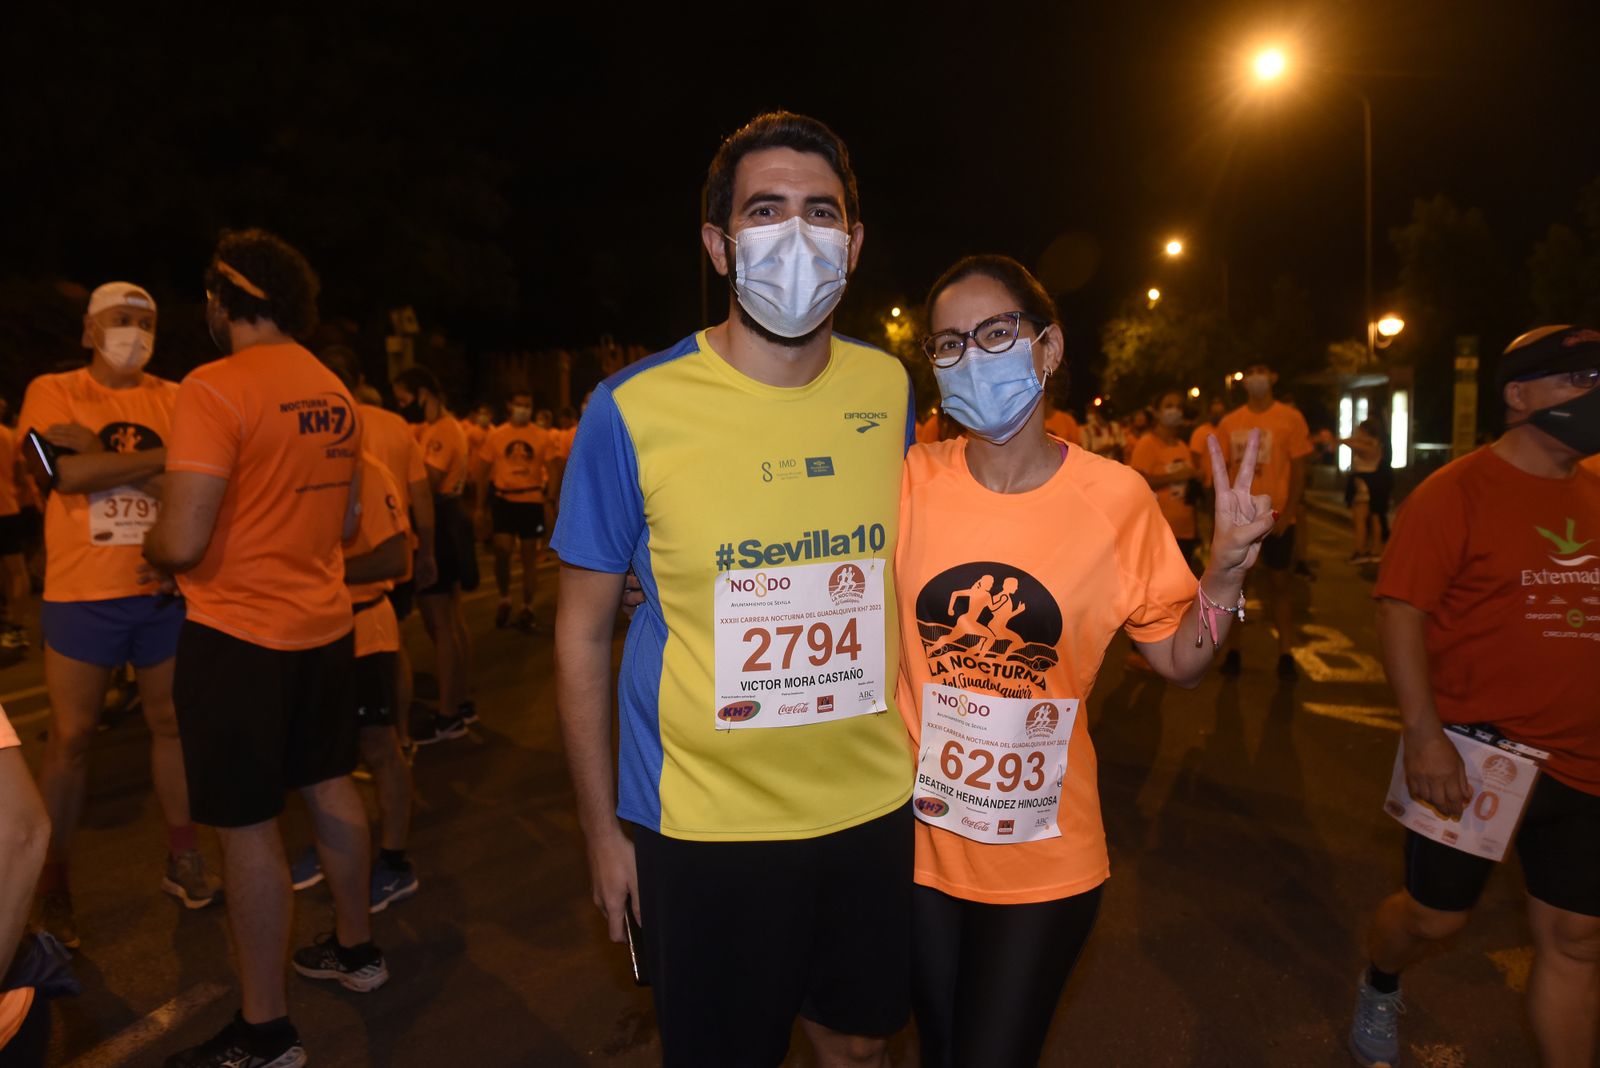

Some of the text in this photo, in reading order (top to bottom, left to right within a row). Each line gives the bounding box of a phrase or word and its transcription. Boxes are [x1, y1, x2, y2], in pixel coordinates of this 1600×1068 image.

[279, 399, 327, 414] NOCTURNA
[844, 411, 888, 420] BROOKS
[779, 459, 797, 469] IMD
[715, 523, 886, 571] #Sevilla10
[740, 615, 770, 624] CARRERA
[770, 613, 805, 623] NOCTURNA
[805, 611, 817, 619] DEL
[816, 607, 857, 618] GUADALQUIVIR
[857, 605, 869, 613] KH7
[741, 617, 862, 673] 2794
[740, 666, 864, 692] VICTOR MORA CASTAÑO
[928, 654, 1047, 691] LA NOCTURNA
[942, 726, 966, 741] CARRERA
[965, 735, 999, 747] NOCTURNA
[940, 740, 1046, 793] 6293
[918, 773, 955, 798] BEATRIZ
[955, 789, 1017, 810] HERNÁNDEZ
[1017, 795, 1058, 809] HINOJOSA
